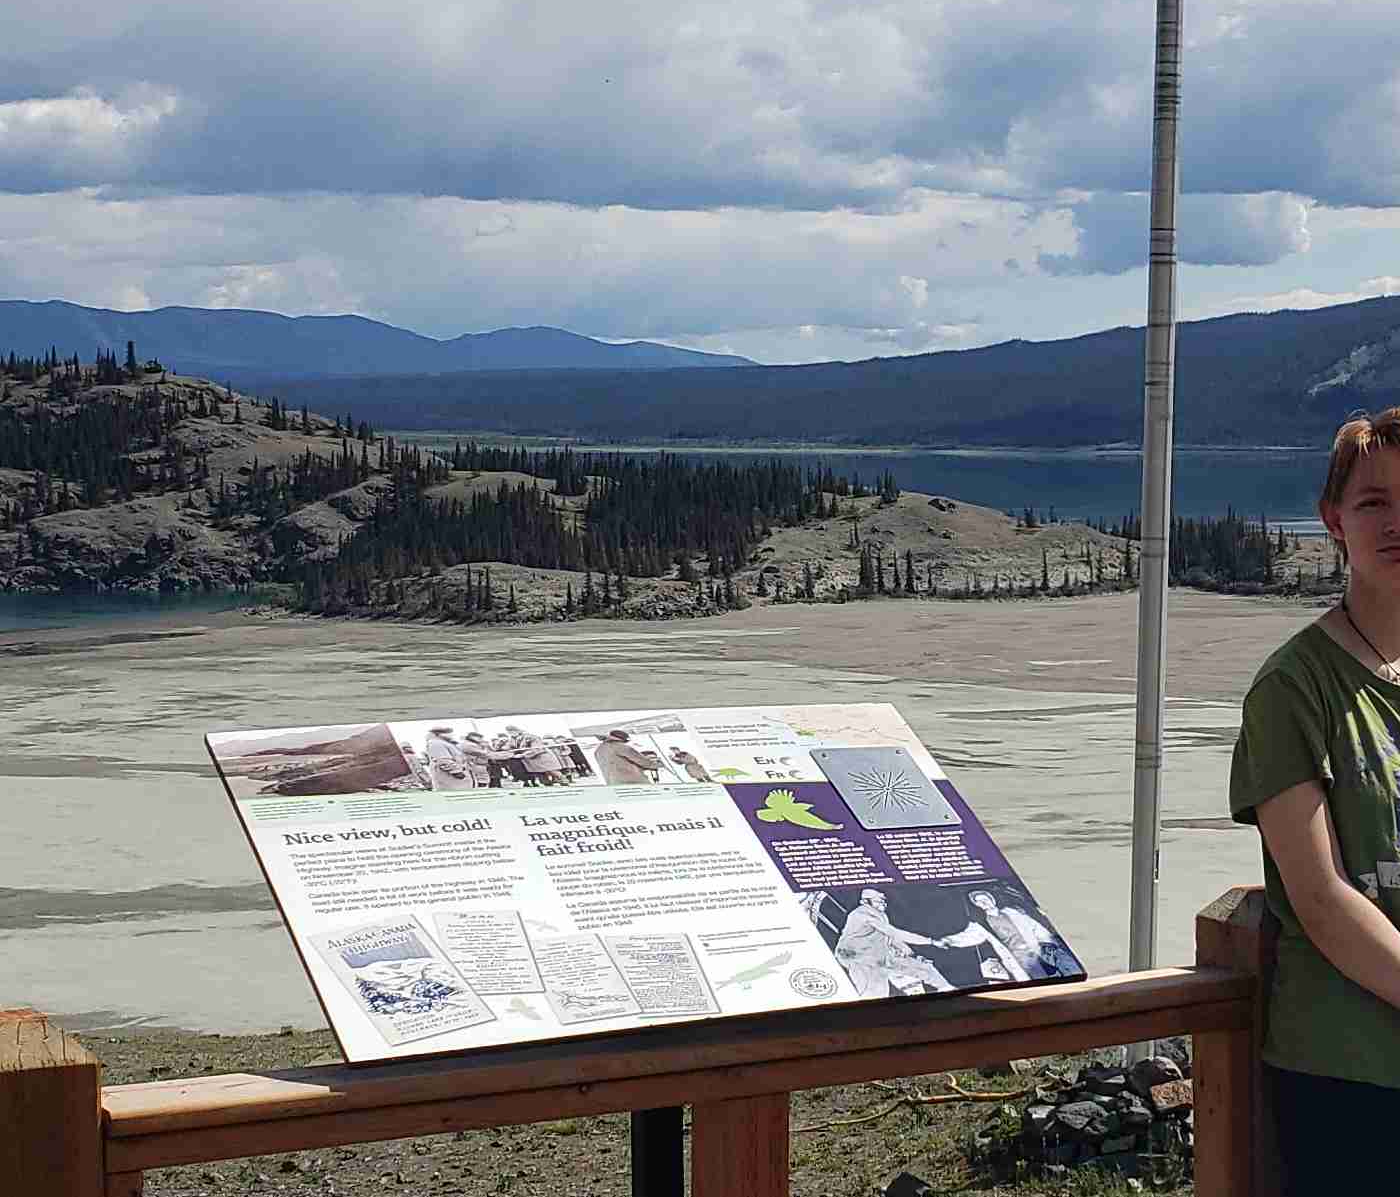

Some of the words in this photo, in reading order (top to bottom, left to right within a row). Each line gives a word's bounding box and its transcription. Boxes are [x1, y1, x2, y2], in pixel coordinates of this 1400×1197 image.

[519, 814, 550, 827] La
[550, 813, 591, 825] vue
[592, 809, 625, 822] est
[528, 822, 655, 843] magnifique,
[655, 818, 707, 833] mais
[707, 816, 726, 829] il
[282, 832, 335, 847] Nice
[337, 827, 398, 842] view,
[398, 822, 440, 838] but
[441, 817, 492, 833] cold!
[536, 842, 574, 857] fait
[576, 838, 635, 854] froid!
